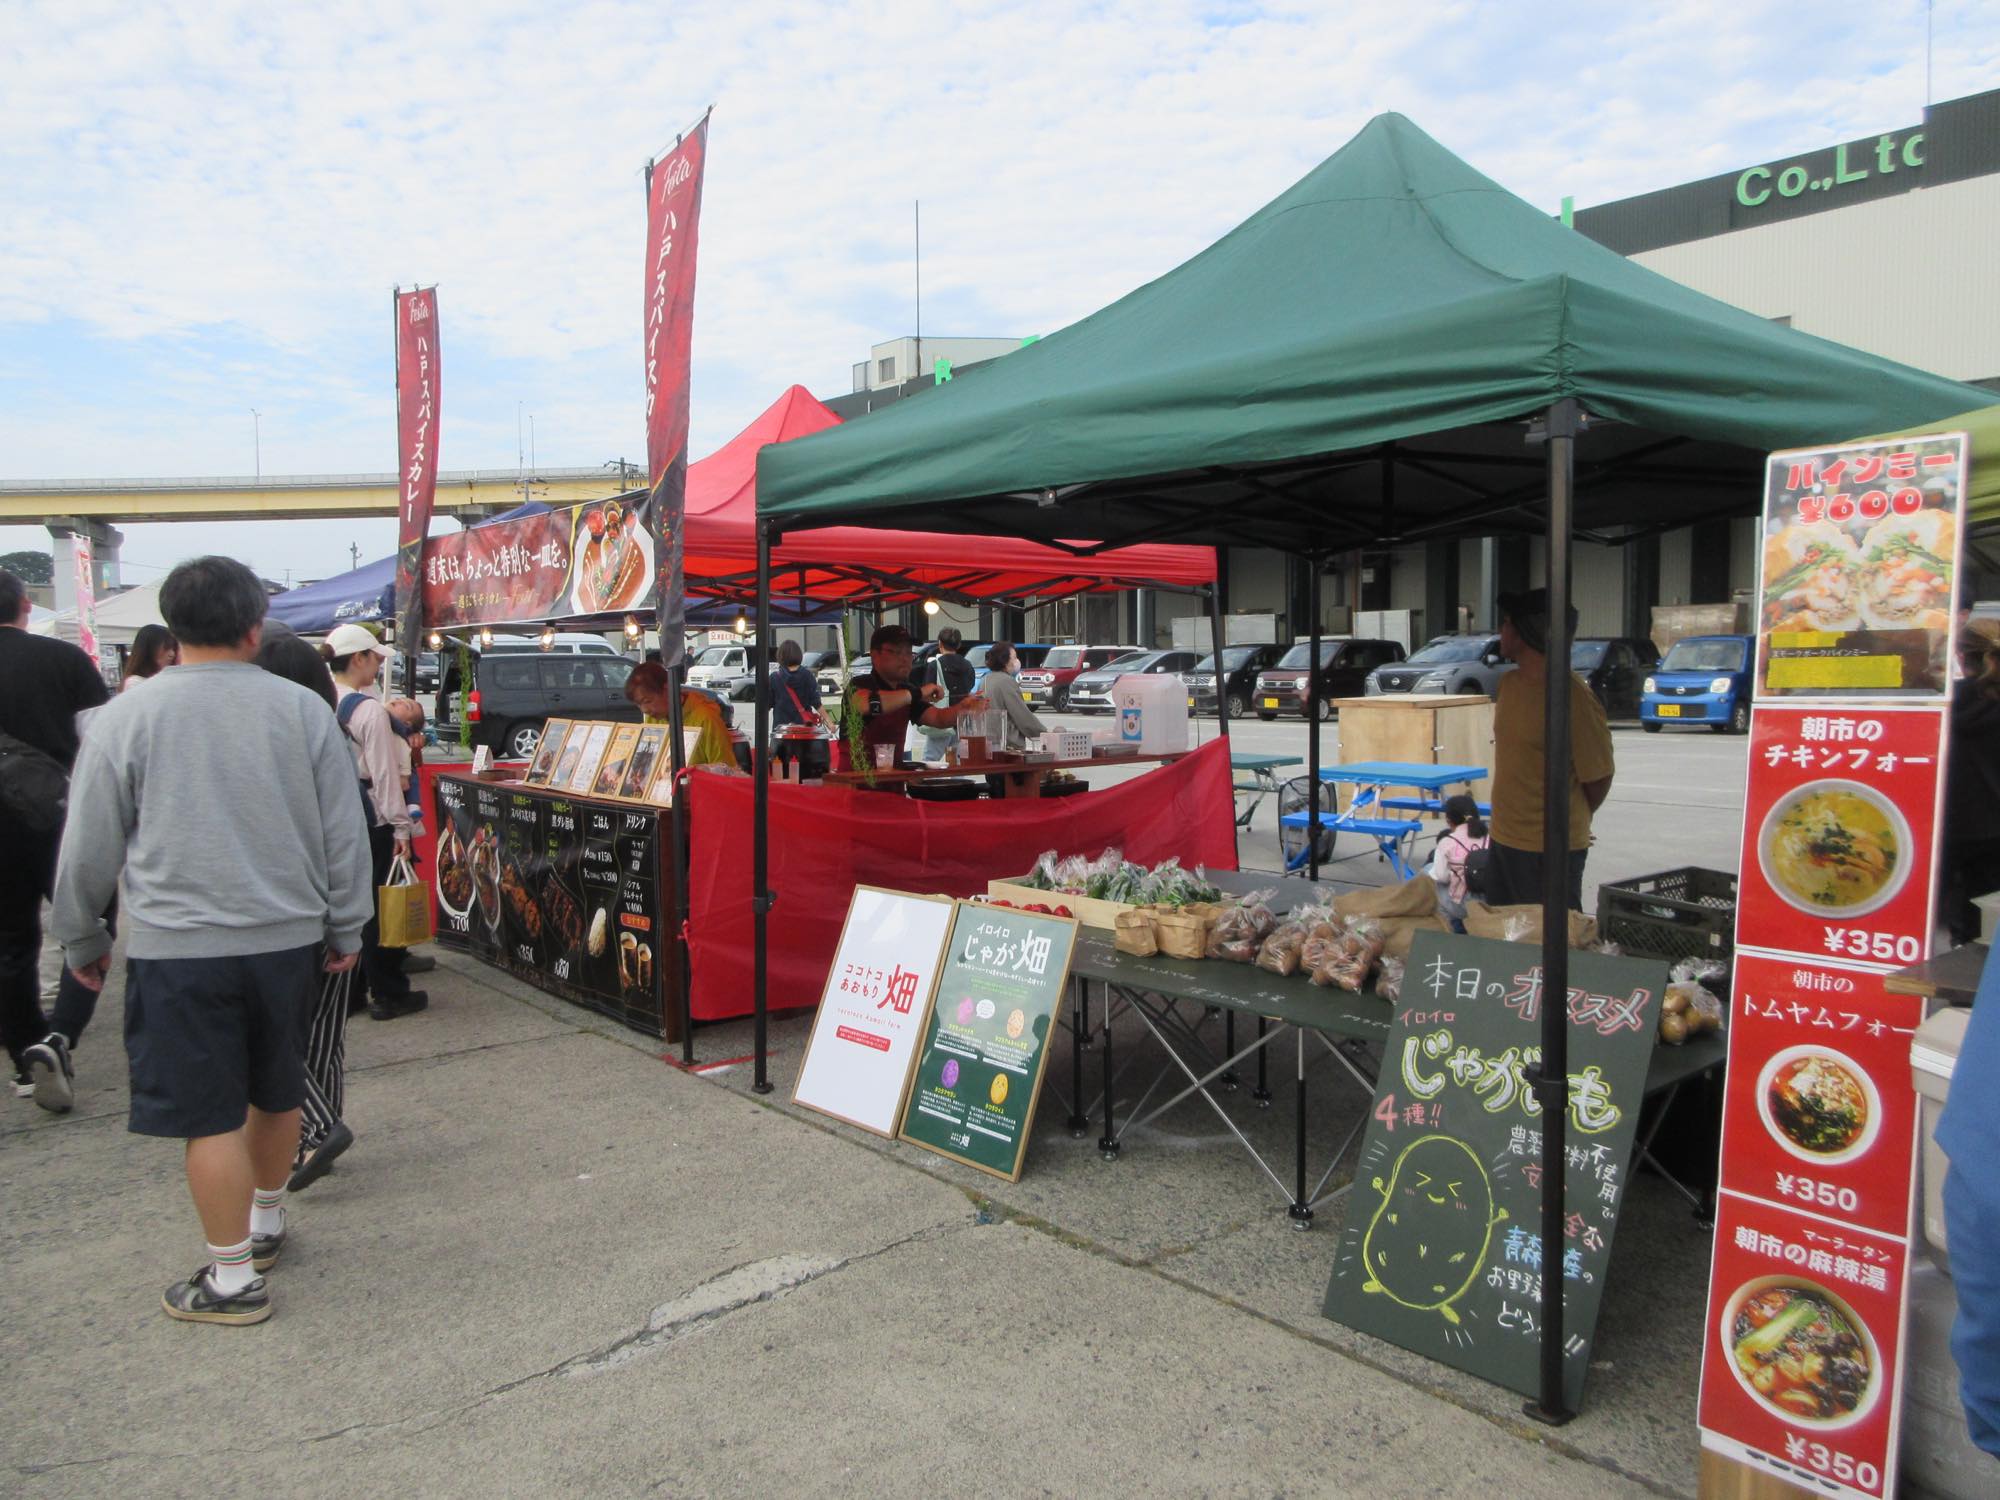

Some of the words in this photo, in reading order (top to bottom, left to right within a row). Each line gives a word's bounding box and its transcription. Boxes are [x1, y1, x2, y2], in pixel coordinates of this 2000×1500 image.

[646, 210, 677, 438] 八戸スパイスカ
[1785, 451, 1955, 491] バインミー
[1797, 487, 1923, 525] ¥600
[1800, 716, 1884, 742] 朝市の
[1764, 744, 1931, 773] チキンフォー
[592, 814, 610, 830] ごはん
[976, 922, 1010, 937] イロイロ
[1823, 926, 1920, 962] ¥350
[963, 929, 1052, 975] じゃが畑
[840, 977, 879, 999] あおもり
[844, 963, 884, 982] ココトコ
[877, 963, 920, 1015] 畑
[1792, 969, 1855, 994] 朝市の
[1400, 1008, 1456, 1027] イロイロ
[1743, 993, 1916, 1038] トムヤムフォー
[1775, 1170, 1858, 1212] ¥350
[1503, 1224, 1594, 1284] 青森産の
[1733, 1225, 1889, 1292] 朝市の麻辣湯
[1802, 1228, 1892, 1263] マーラータン
[1784, 1430, 1880, 1490] ¥350
